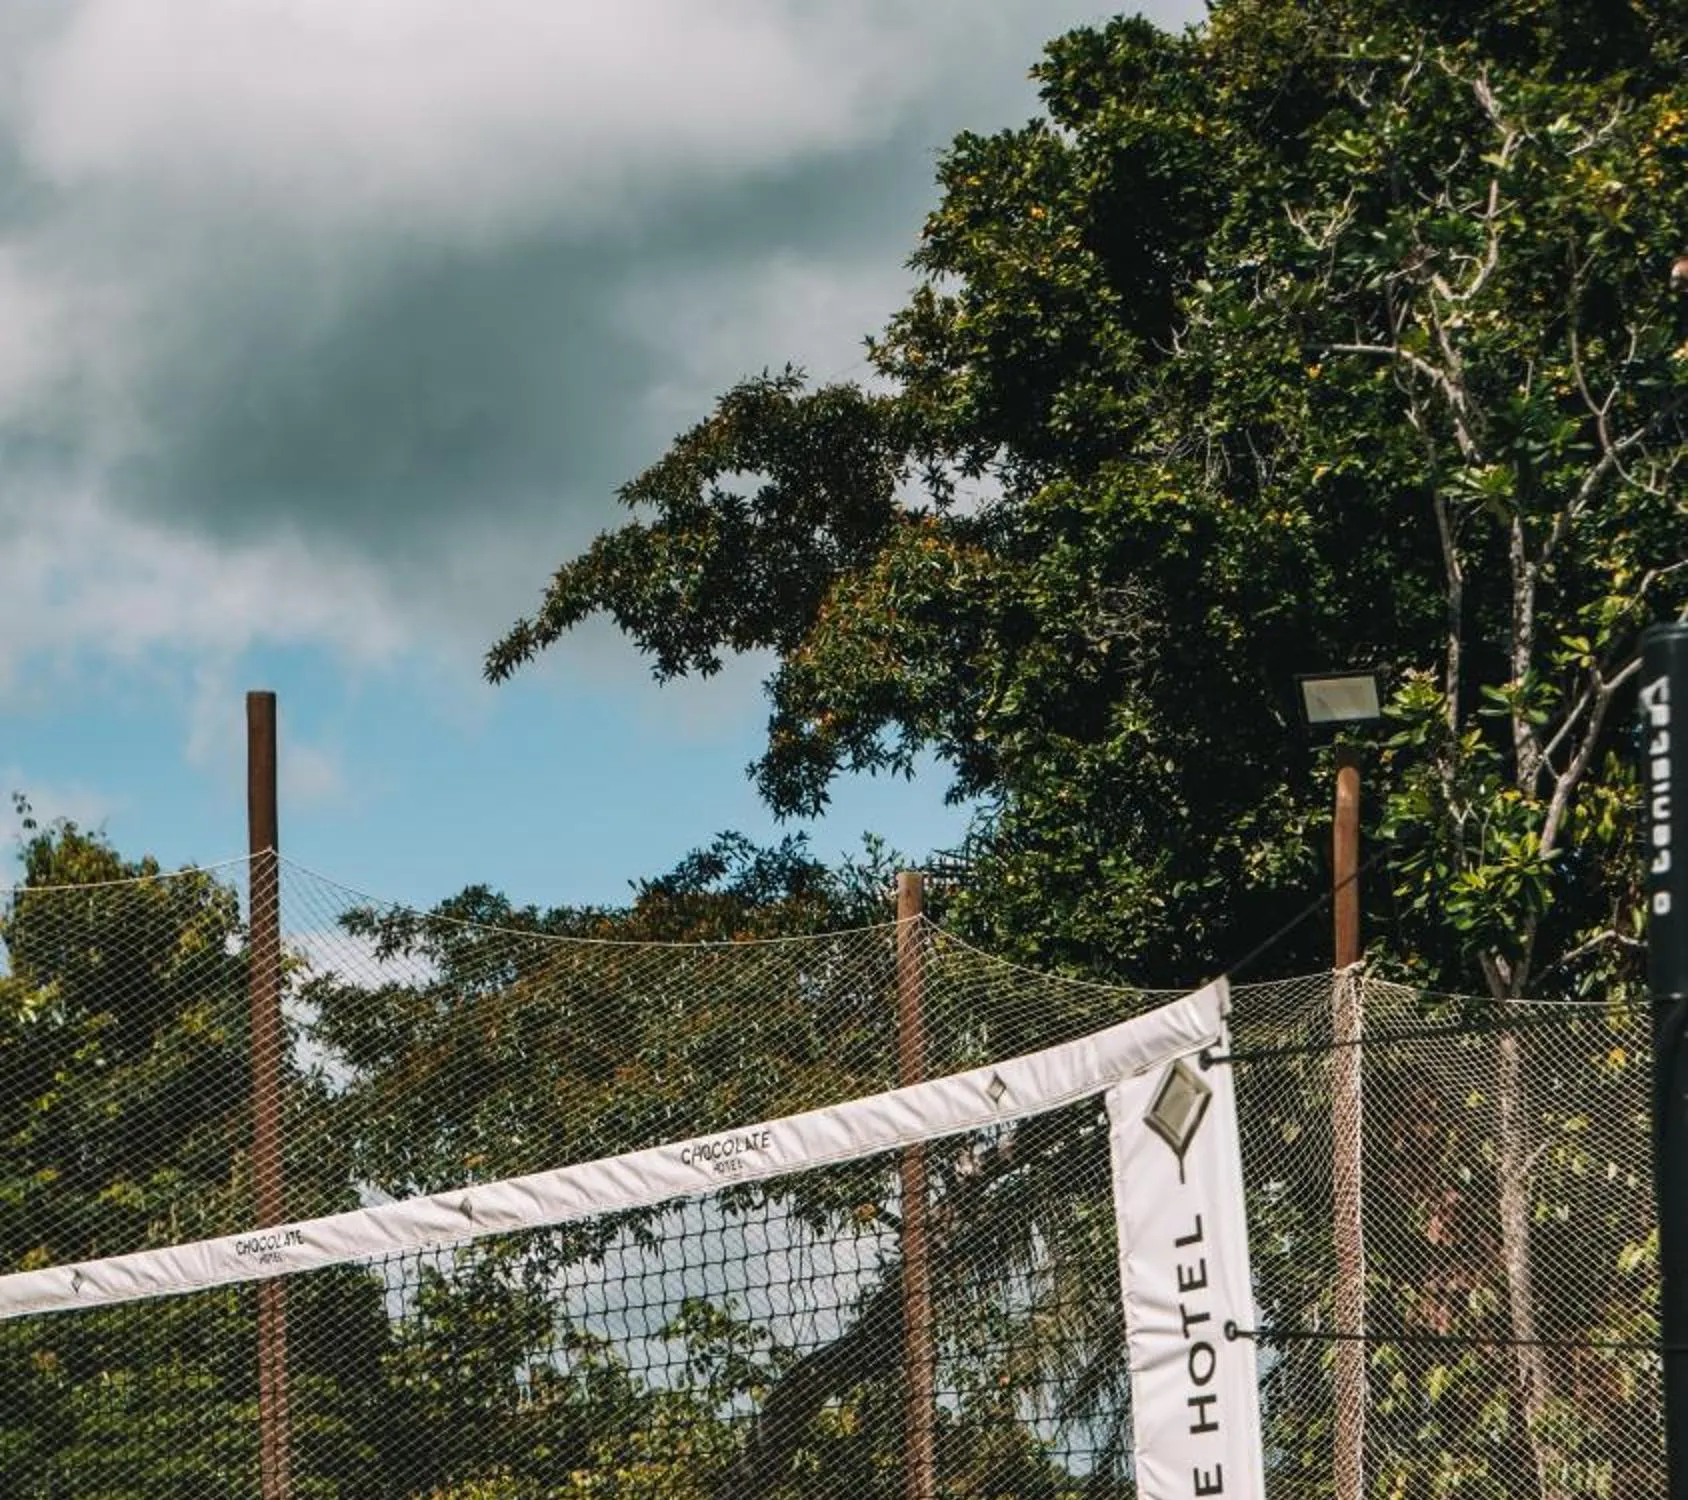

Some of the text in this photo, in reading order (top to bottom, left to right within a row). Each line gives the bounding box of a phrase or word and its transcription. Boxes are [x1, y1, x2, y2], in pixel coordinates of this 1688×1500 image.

[681, 1130, 770, 1166] CHOCOLATE
[714, 1159, 743, 1173] HOTEL
[236, 1229, 304, 1256] CHOCOLATE
[1174, 1214, 1219, 1434] HOTEL
